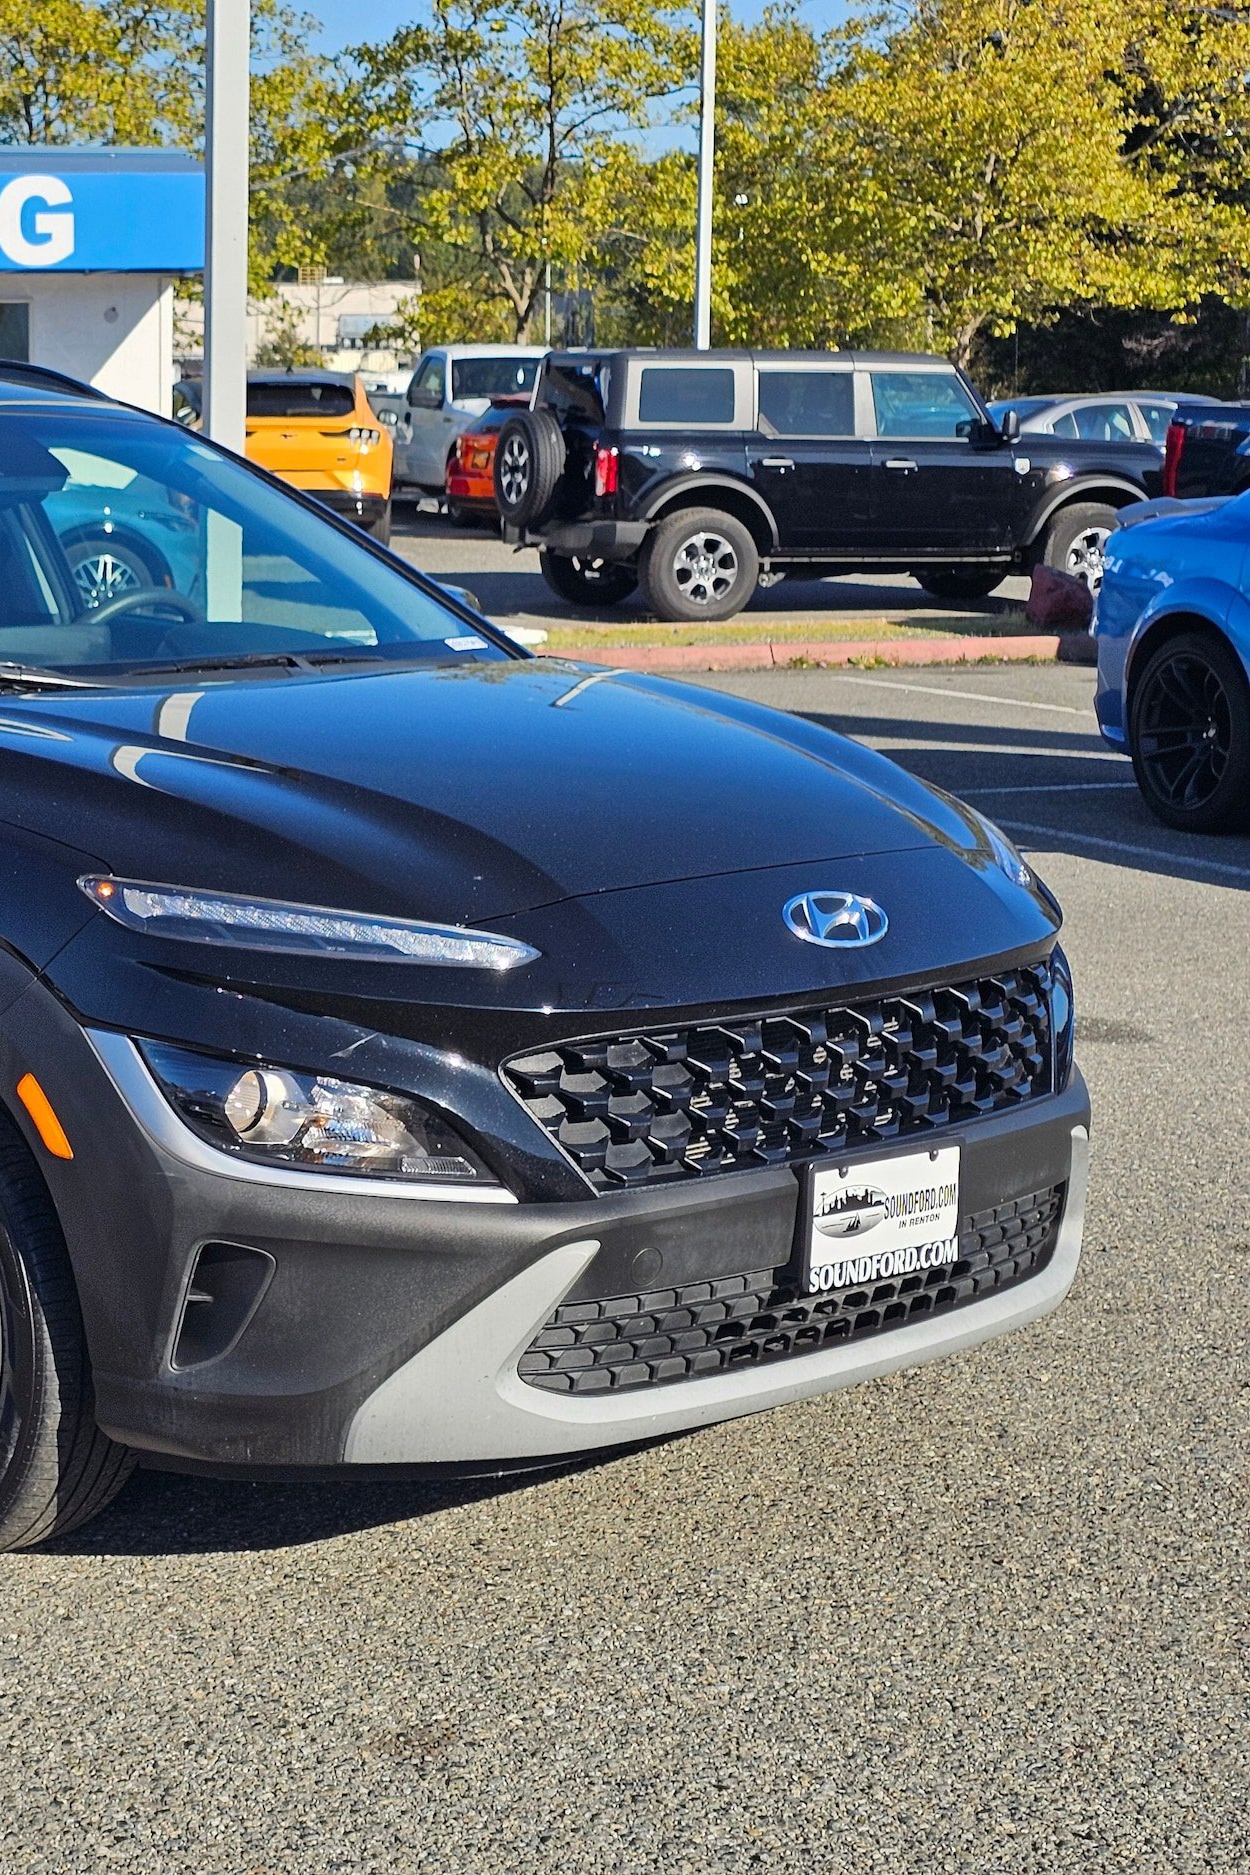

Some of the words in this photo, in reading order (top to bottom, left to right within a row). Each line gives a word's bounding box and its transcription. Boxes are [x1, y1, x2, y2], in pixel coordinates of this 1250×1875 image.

[884, 1183, 956, 1219] SOUNDFORD.COM
[898, 1219, 907, 1229] IN
[910, 1213, 940, 1227] RENTON
[809, 1236, 958, 1293] SOUNDFORD.COM
